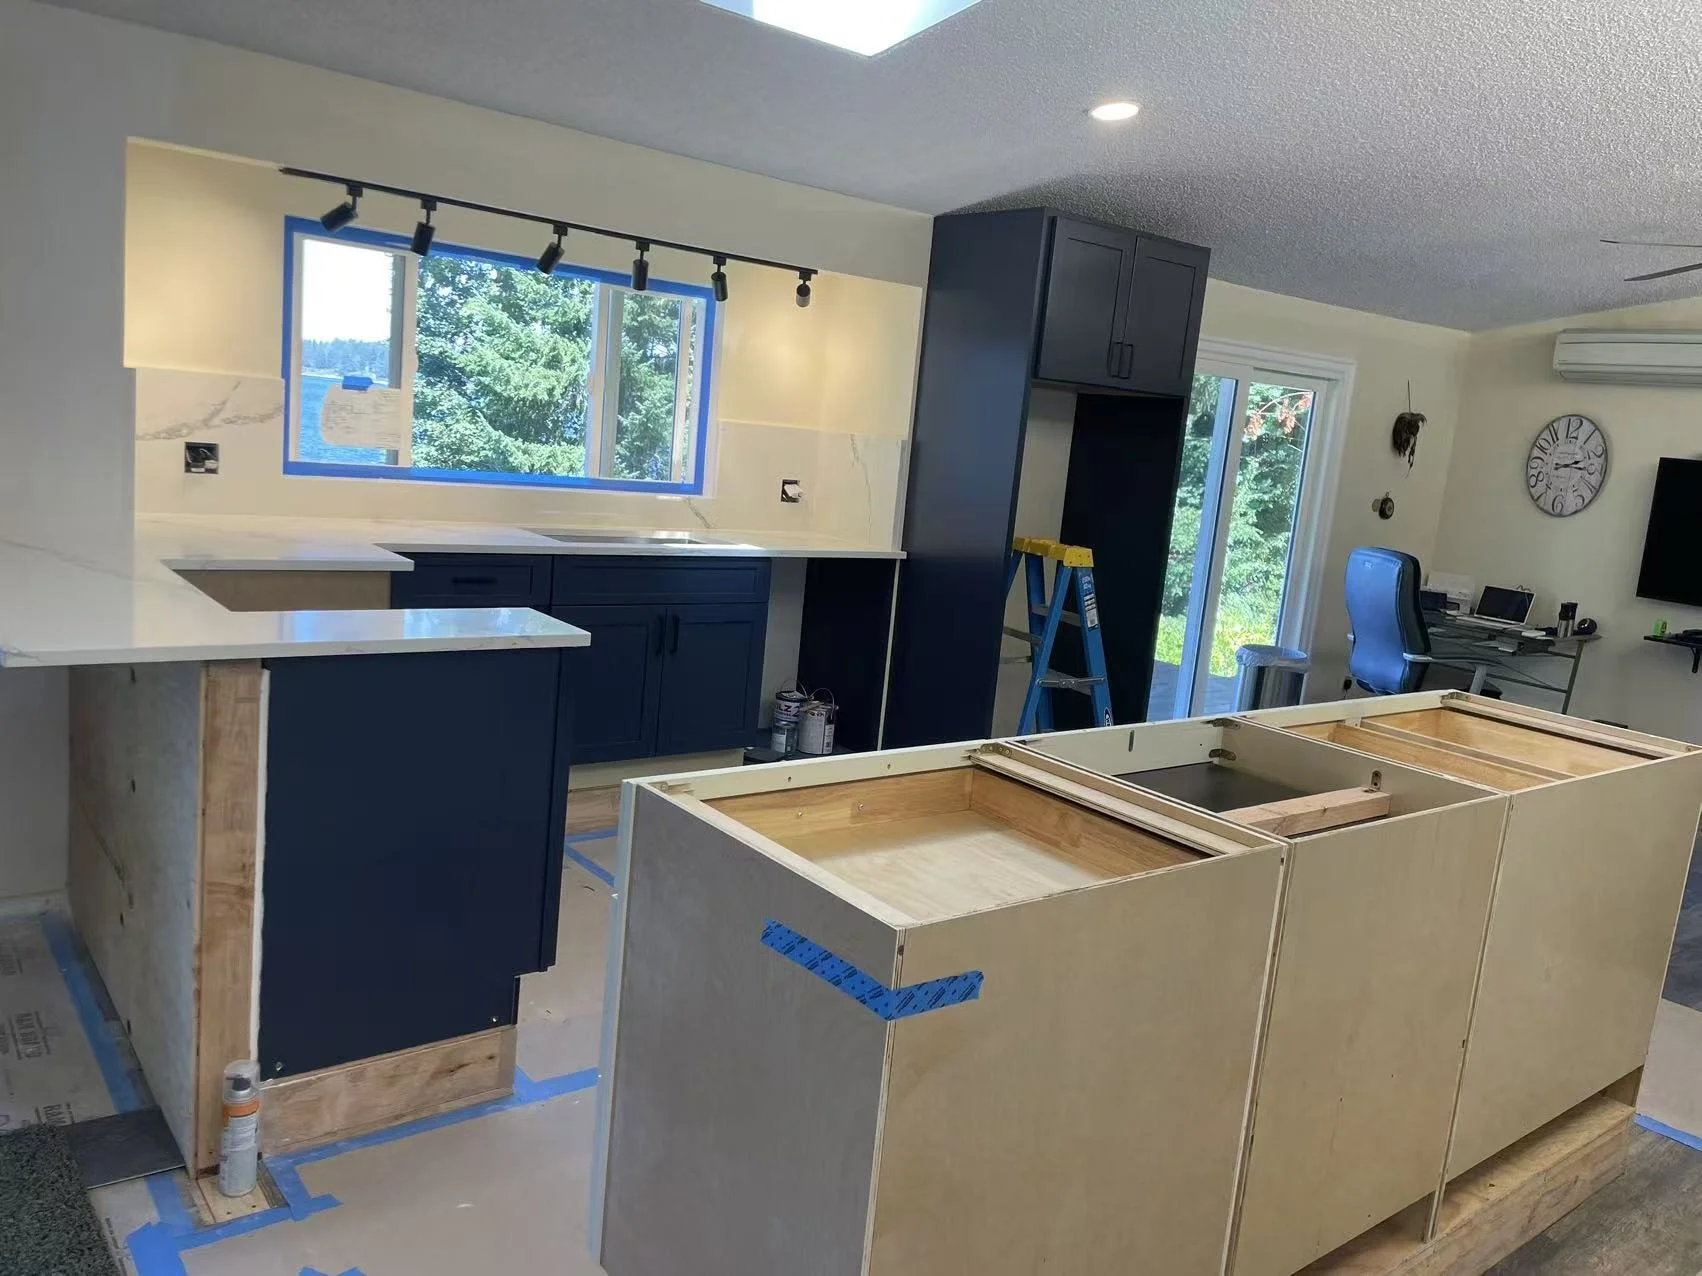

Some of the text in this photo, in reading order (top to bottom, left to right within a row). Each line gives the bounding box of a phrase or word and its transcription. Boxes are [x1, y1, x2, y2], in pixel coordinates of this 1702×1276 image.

[1548, 423, 1560, 444] 11
[1565, 418, 1584, 440] 12
[1583, 428, 1597, 445] 1
[1535, 437, 1552, 456] 10
[1586, 443, 1605, 461] 2
[1529, 456, 1545, 470] 9
[1529, 470, 1545, 489] 8
[1551, 494, 1565, 514] 6
